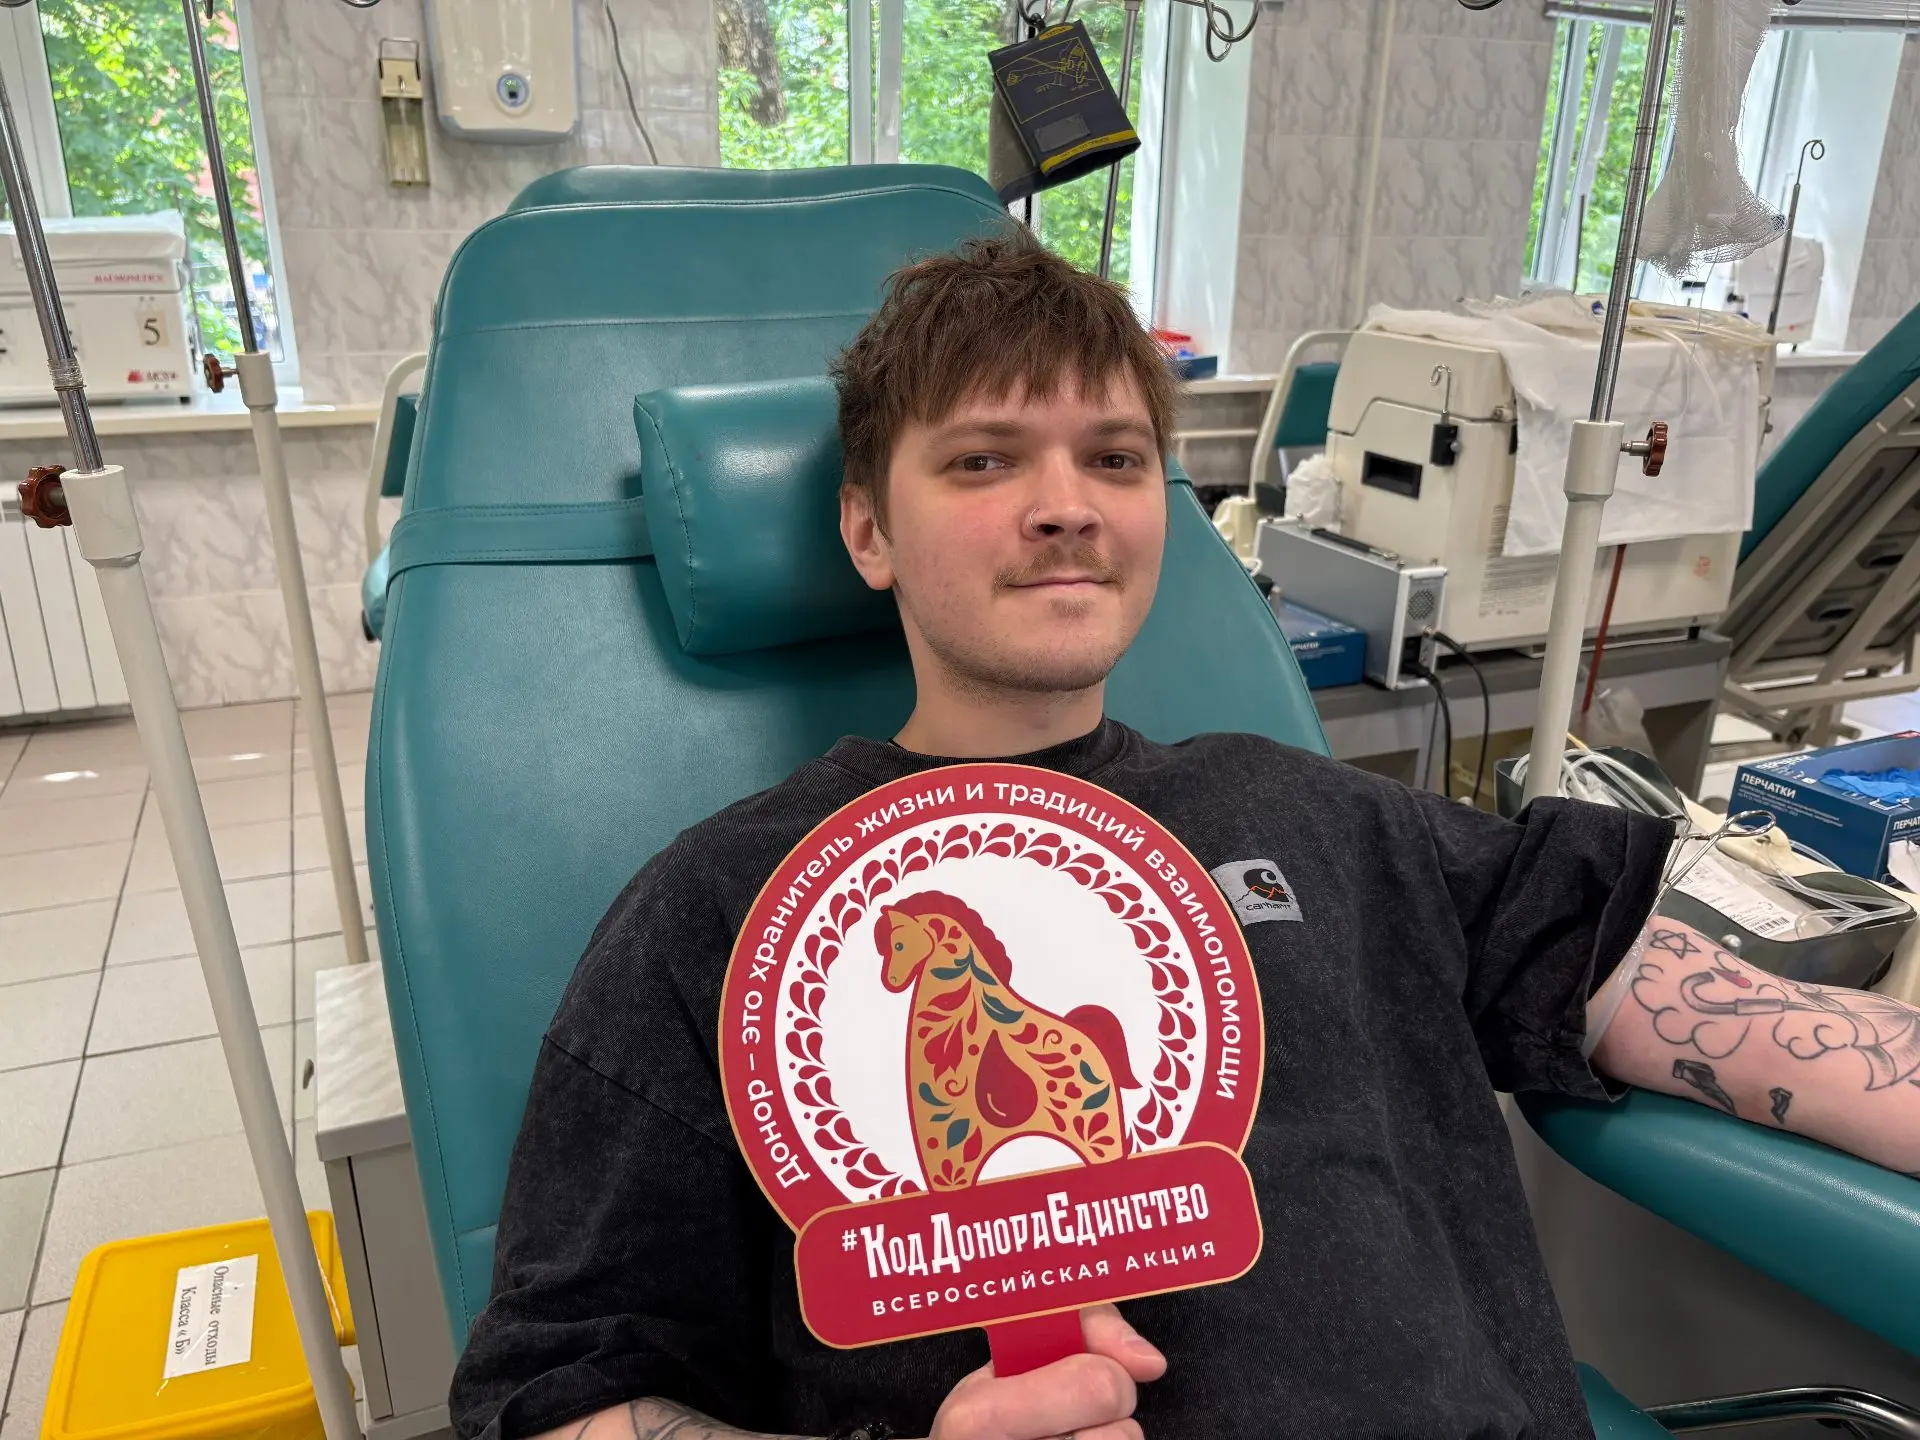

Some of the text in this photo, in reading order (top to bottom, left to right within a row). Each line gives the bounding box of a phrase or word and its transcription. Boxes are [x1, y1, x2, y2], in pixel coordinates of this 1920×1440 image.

[143, 318, 161, 346] 5
[853, 785, 956, 839] жизни
[965, 782, 984, 801] и
[993, 781, 1147, 852] традиций
[1741, 772, 1797, 799] ПЕРЧАТКИ
[748, 835, 854, 982] хранитель
[1143, 848, 1241, 1100] взаимопомощи
[741, 989, 763, 1045] это
[747, 1079, 811, 1189] Донор
[177, 1286, 198, 1328] Класса
[871, 1240, 1217, 1317] ВСЕРОССИЙСКАЯ АКЦИЯ
[204, 1266, 229, 1366] Опасные отходы
